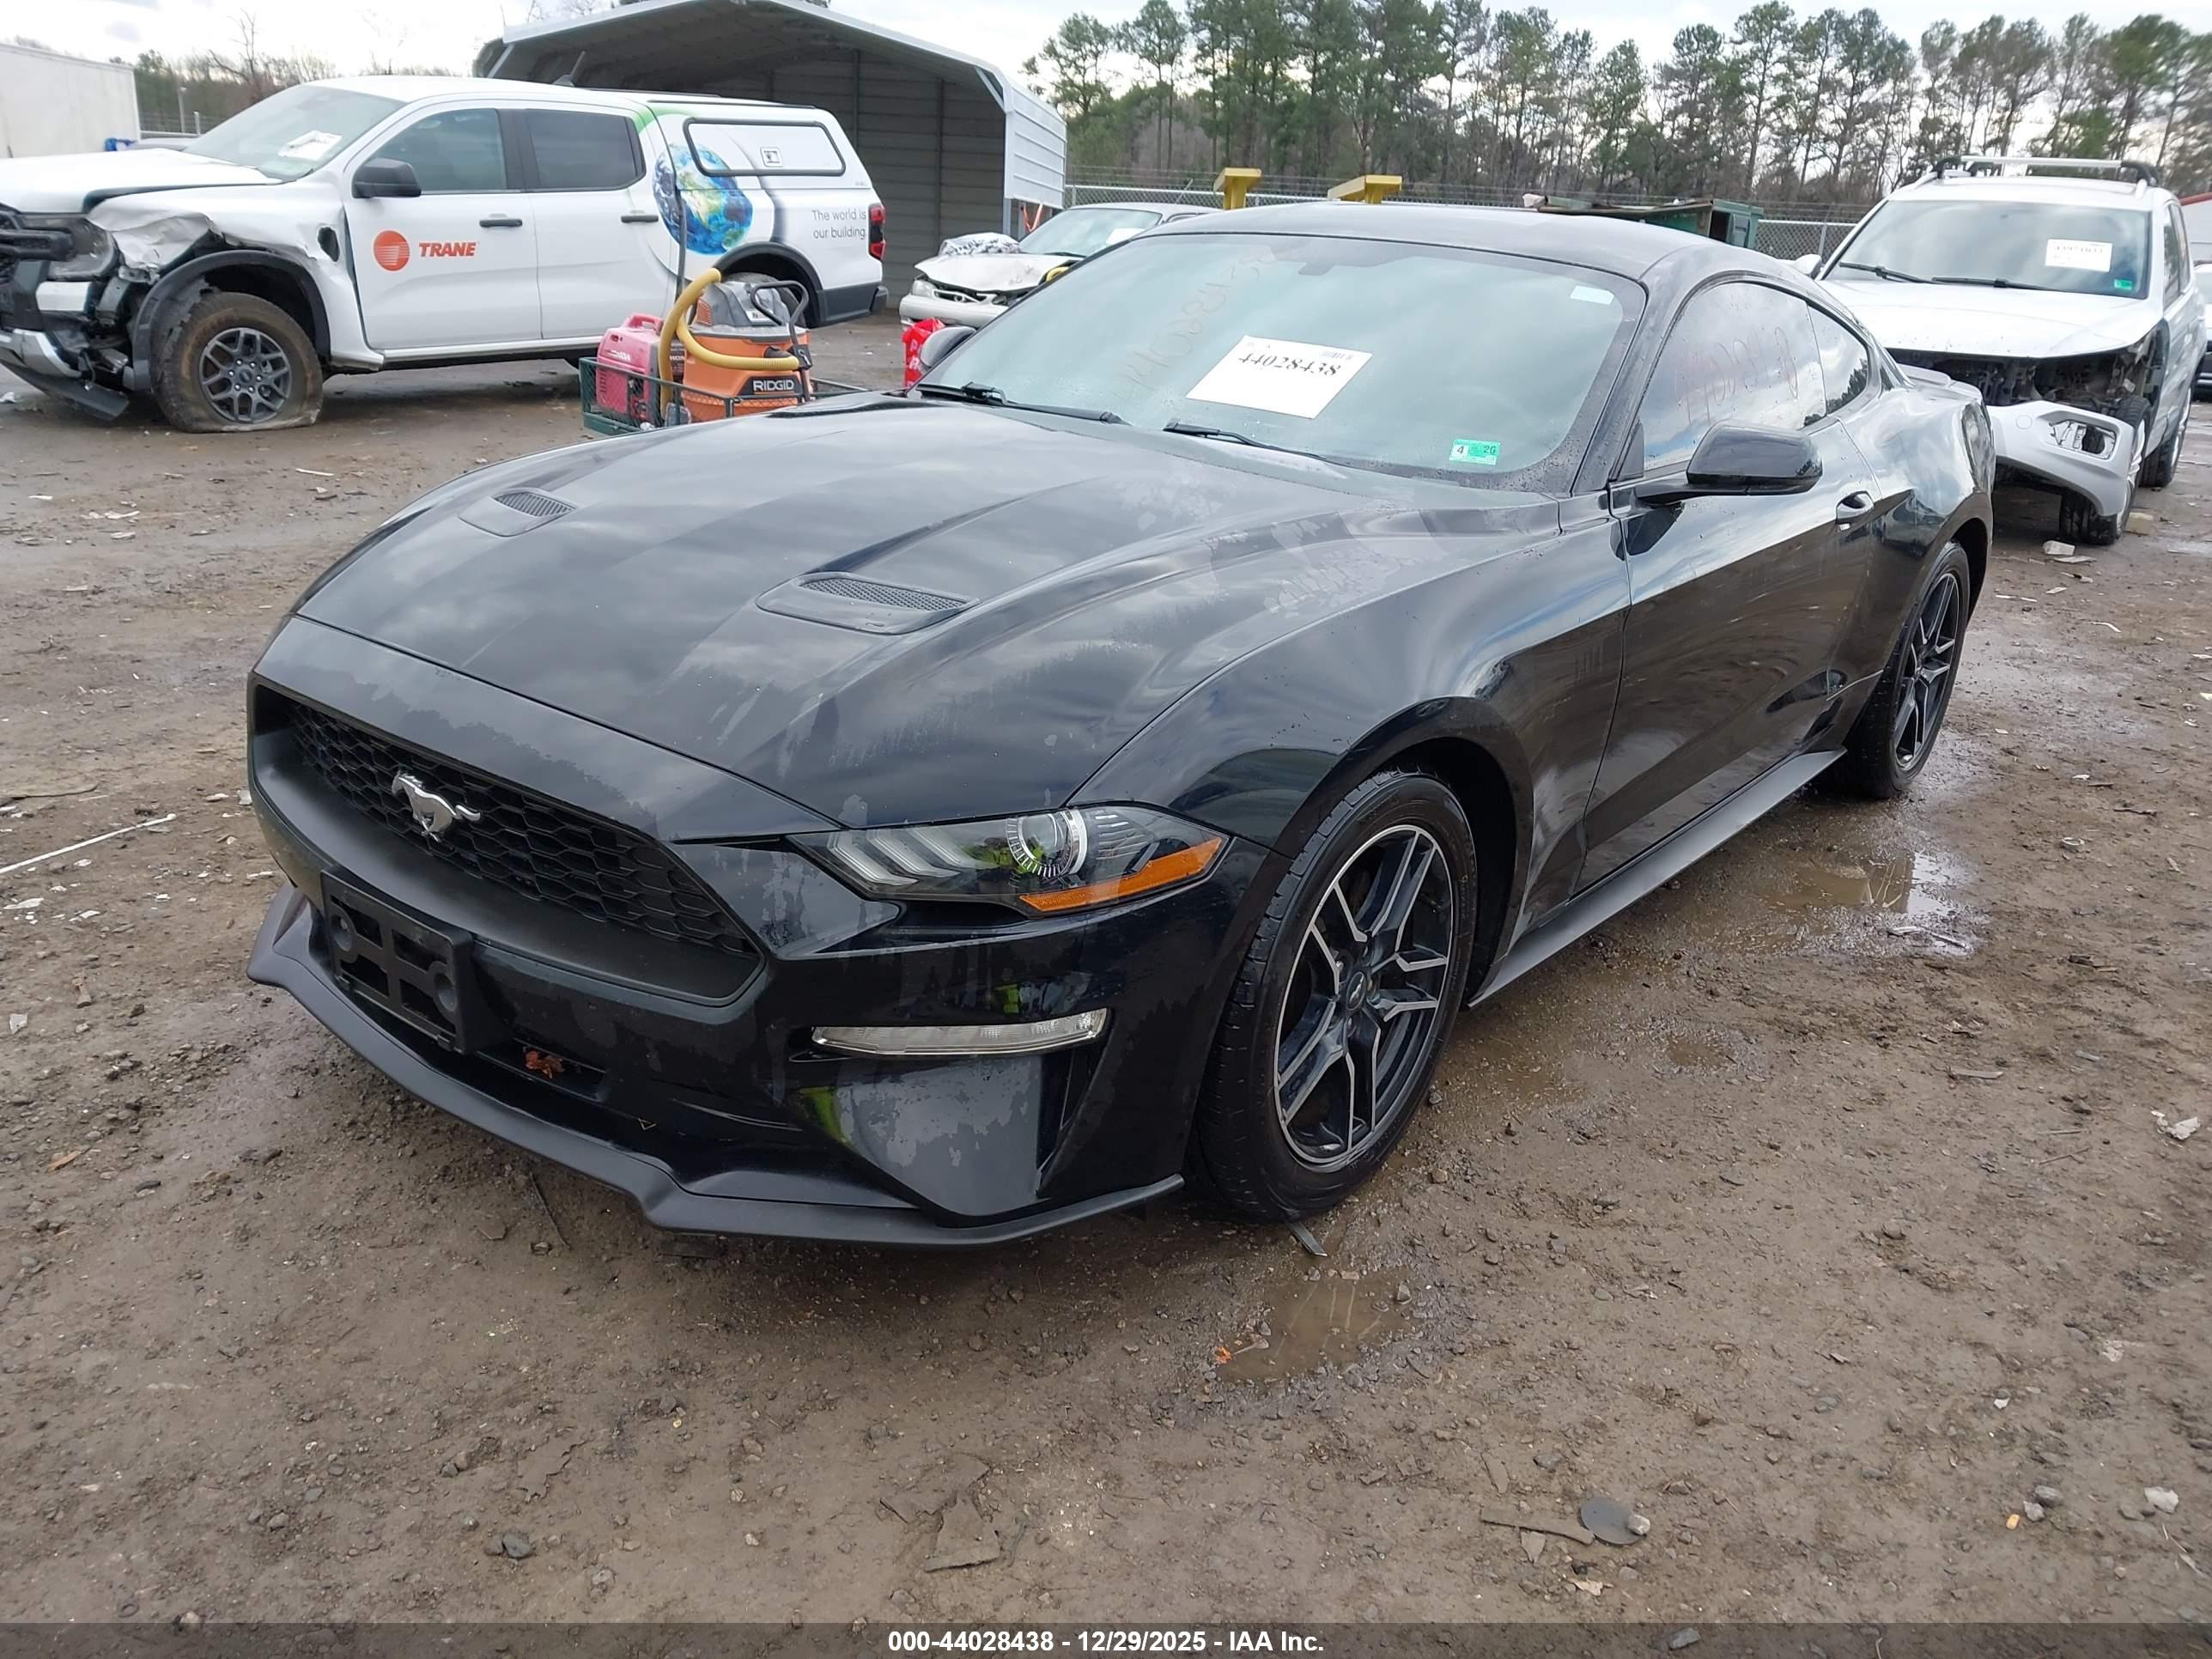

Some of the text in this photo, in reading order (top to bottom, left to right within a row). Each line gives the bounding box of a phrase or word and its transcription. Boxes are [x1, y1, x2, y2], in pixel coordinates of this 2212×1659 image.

[811, 208, 866, 221] The world is
[813, 229, 828, 239] our
[418, 241, 477, 257] TRANE
[1237, 352, 1342, 376] 44028438
[753, 380, 794, 392] RIDGID
[1456, 445, 1464, 454] 4
